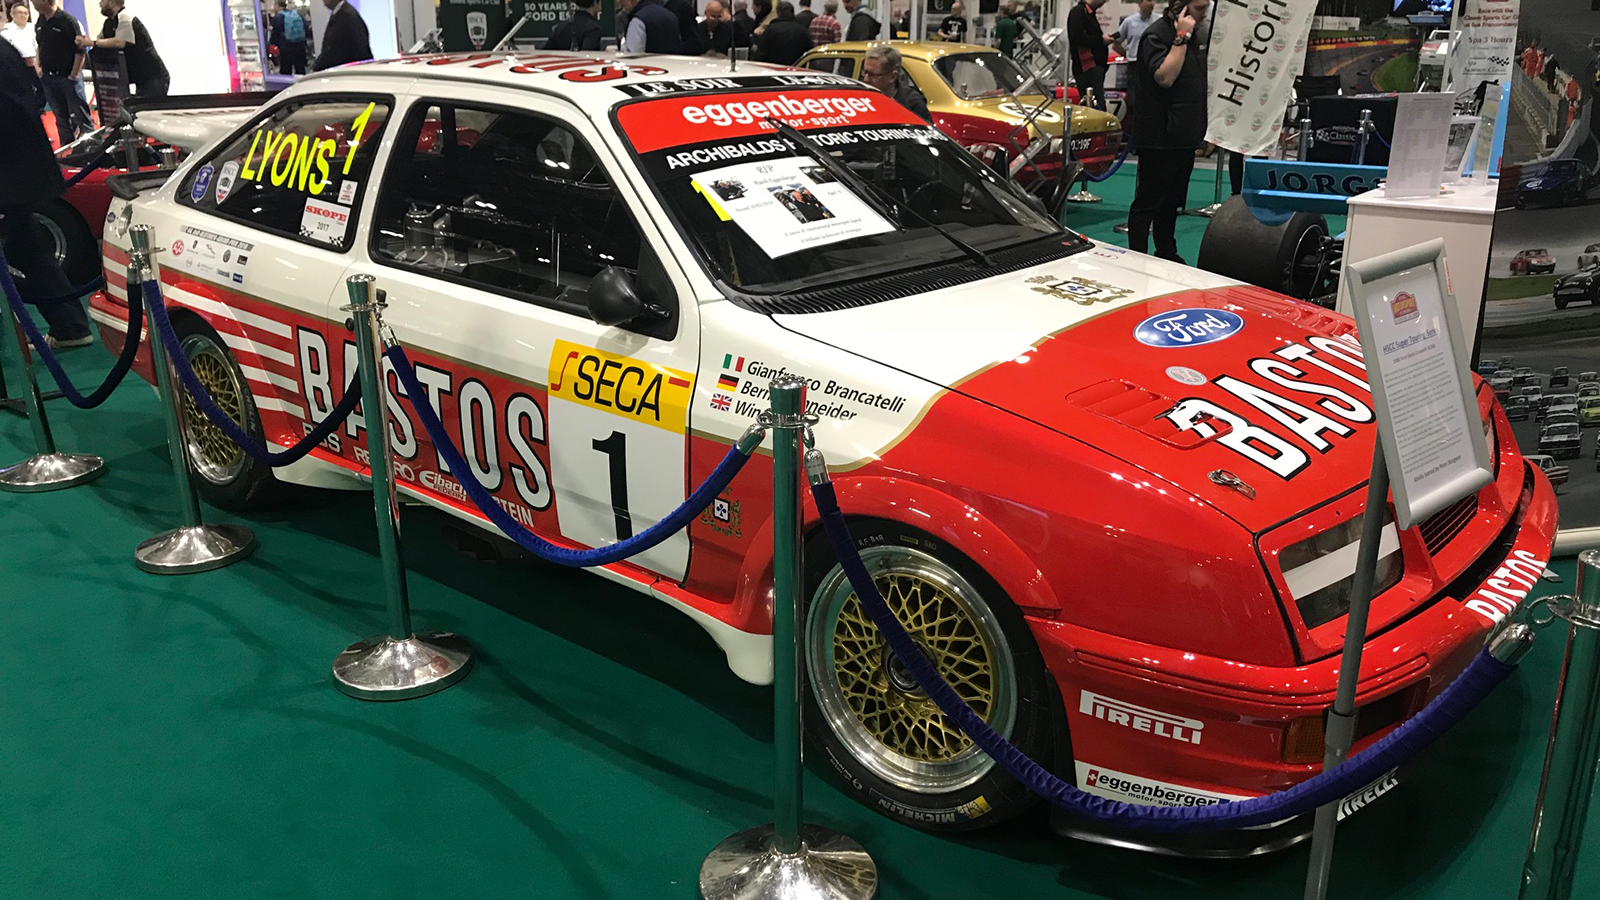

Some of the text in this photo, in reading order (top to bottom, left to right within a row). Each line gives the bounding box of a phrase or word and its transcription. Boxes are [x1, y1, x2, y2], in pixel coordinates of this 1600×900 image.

[538, 3, 569, 11] YEARS
[1469, 36, 1481, 44] Spa
[629, 78, 743, 94] LE SOIR
[772, 76, 803, 86] LE
[682, 95, 876, 126] eggenberger
[342, 102, 375, 175] 1
[665, 138, 784, 170] ARCHIBALDS
[854, 128, 916, 144] TOURING
[240, 129, 336, 195] LYONS
[1266, 169, 1386, 195] JORG
[305, 205, 347, 222] SKOPE
[317, 222, 330, 231] 2017
[1153, 313, 1230, 343] Ford
[573, 353, 663, 422] SECA
[824, 380, 907, 413] Brancatelli
[433, 485, 467, 501] FEDERN
[592, 430, 634, 542] 1
[1079, 689, 1204, 745] PIRELLI
[1098, 774, 1217, 808] eggenberger
[1336, 765, 1400, 822] PIRELLI
[877, 797, 956, 823] MICHELIN
